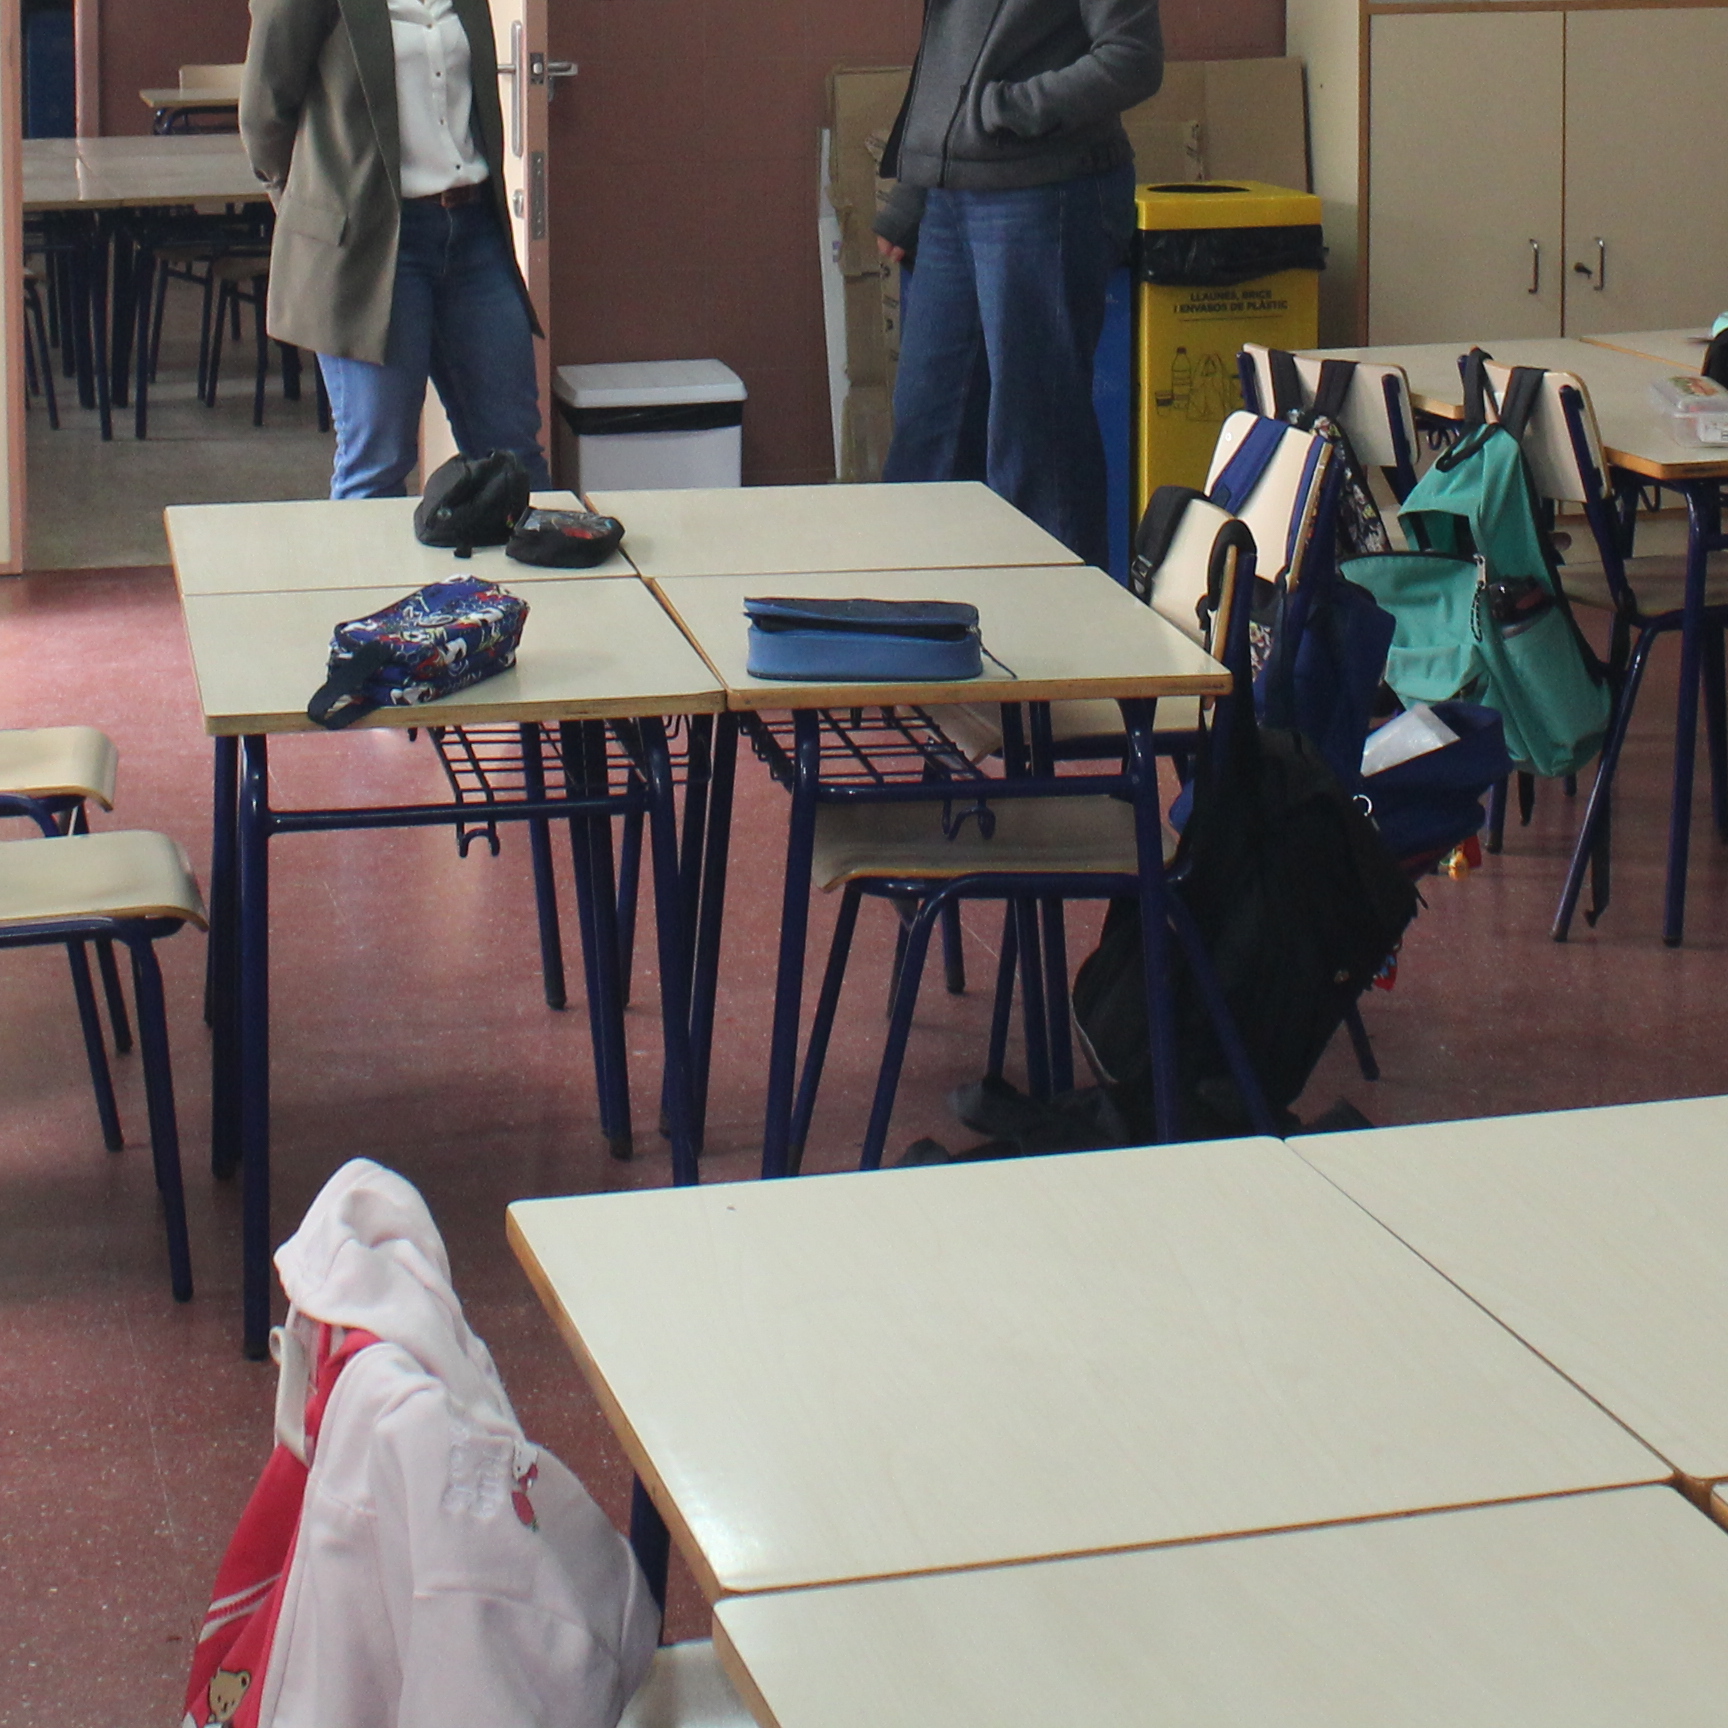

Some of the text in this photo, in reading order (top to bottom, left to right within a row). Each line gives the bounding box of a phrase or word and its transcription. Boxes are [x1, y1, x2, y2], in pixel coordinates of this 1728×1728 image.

[1180, 302, 1228, 314] ENVASOS
[1230, 301, 1244, 312] DE
[1246, 299, 1288, 311] PLÀSTIC
